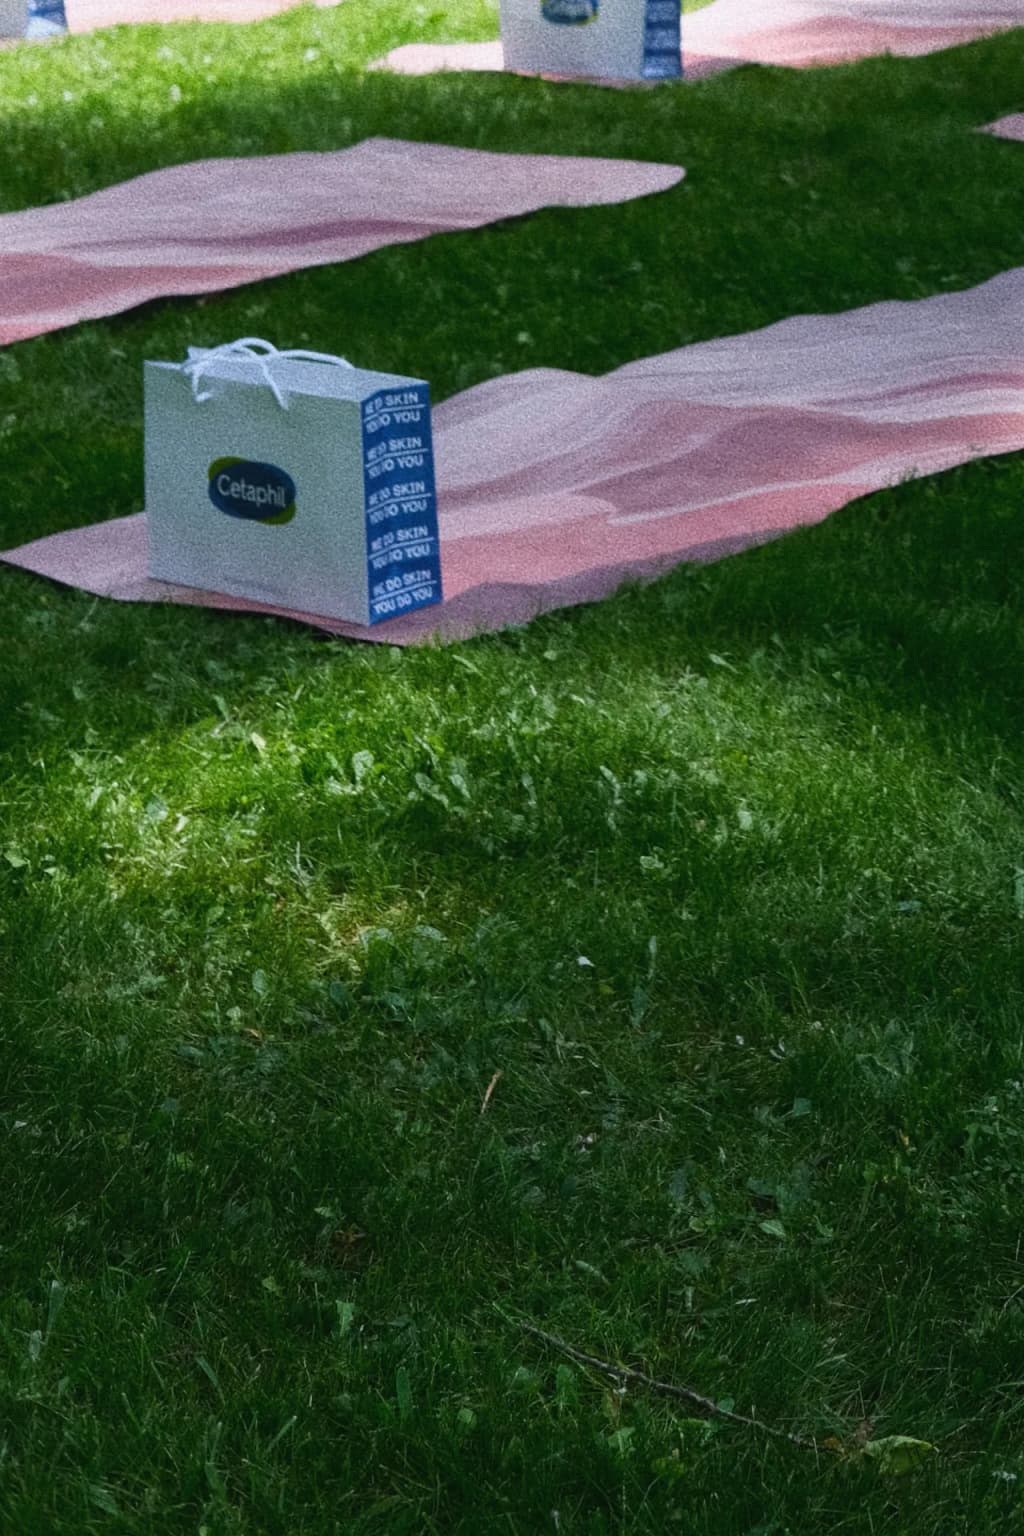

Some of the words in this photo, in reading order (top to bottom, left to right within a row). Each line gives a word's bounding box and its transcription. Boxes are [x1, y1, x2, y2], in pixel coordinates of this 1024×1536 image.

[385, 392, 419, 406] SKIN
[394, 409, 421, 424] YOU
[389, 436, 422, 452] SKIN
[397, 454, 424, 469] YOU
[217, 473, 287, 508] Cetaphil
[392, 481, 425, 497] SKIN
[402, 498, 428, 514] YOU
[396, 525, 428, 542] SKIN
[406, 543, 431, 558] YOU
[386, 575, 402, 590] DO
[404, 569, 432, 586] SKIN
[374, 599, 396, 615] YOU
[396, 594, 412, 609] DO
[413, 586, 434, 601] YOU
